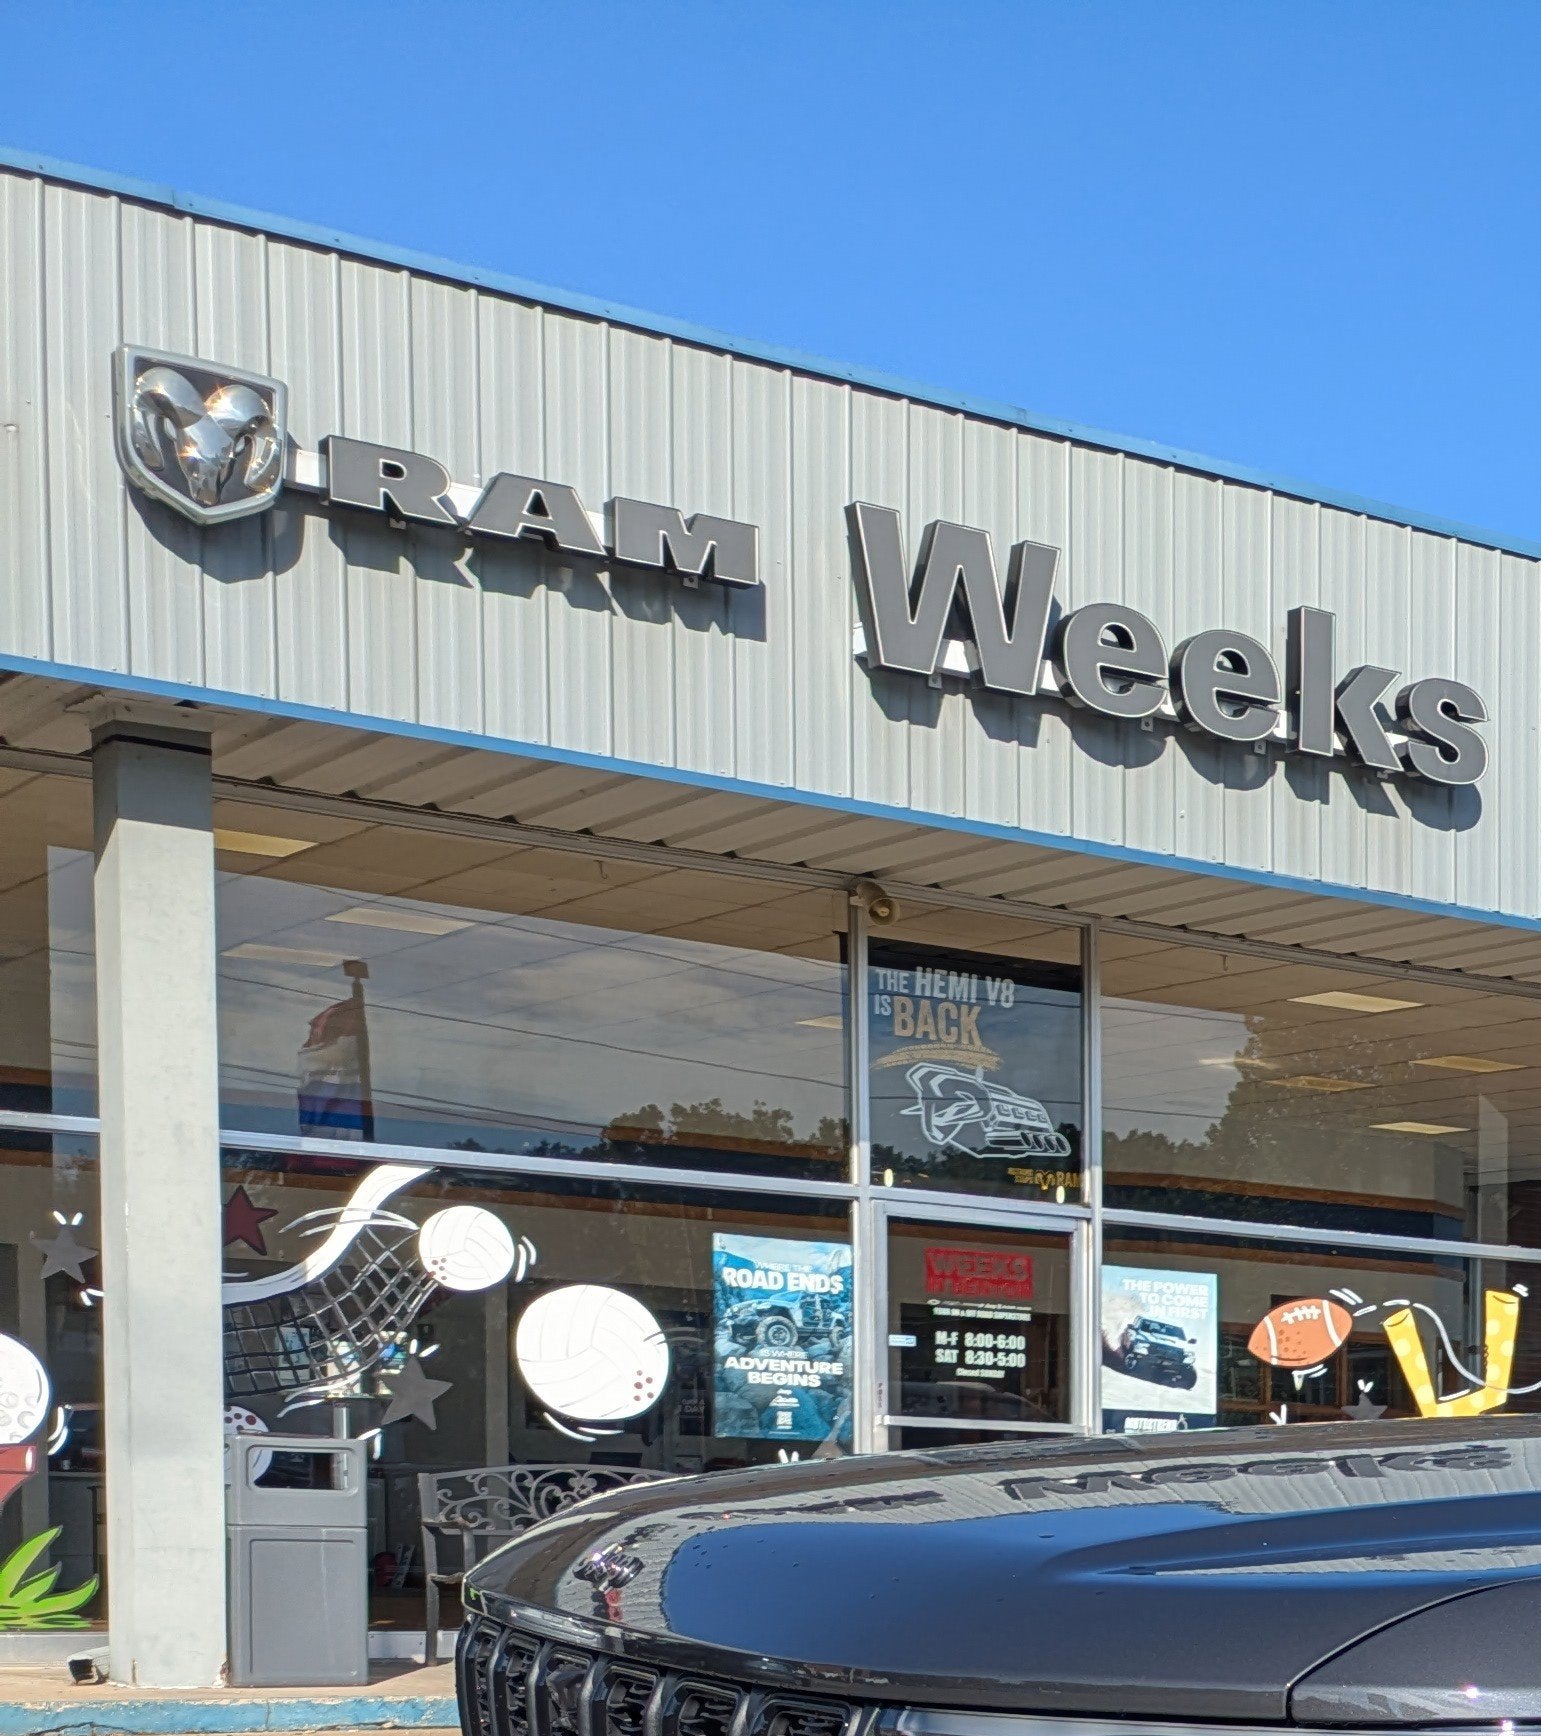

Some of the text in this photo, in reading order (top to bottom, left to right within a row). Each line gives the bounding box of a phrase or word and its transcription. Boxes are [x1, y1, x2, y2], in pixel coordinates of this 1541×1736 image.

[320, 434, 760, 590] RAM
[845, 501, 1489, 786] Weeks
[876, 966, 1015, 1008] THE HEMI V8
[874, 994, 984, 1048] IS BACK
[722, 1267, 843, 1294] ROAD ENDS
[1123, 1279, 1208, 1296] THE POWER
[1140, 1292, 1208, 1308] TO COME
[1169, 1306, 1208, 1319] FIRST
[935, 1331, 959, 1345] M-F
[964, 1332, 1026, 1350] 8:00-6:00
[724, 1356, 843, 1375] ADVENTURE
[935, 1349, 1026, 1368] SAT 8:30-5:00
[748, 1371, 821, 1388] BEGINS
